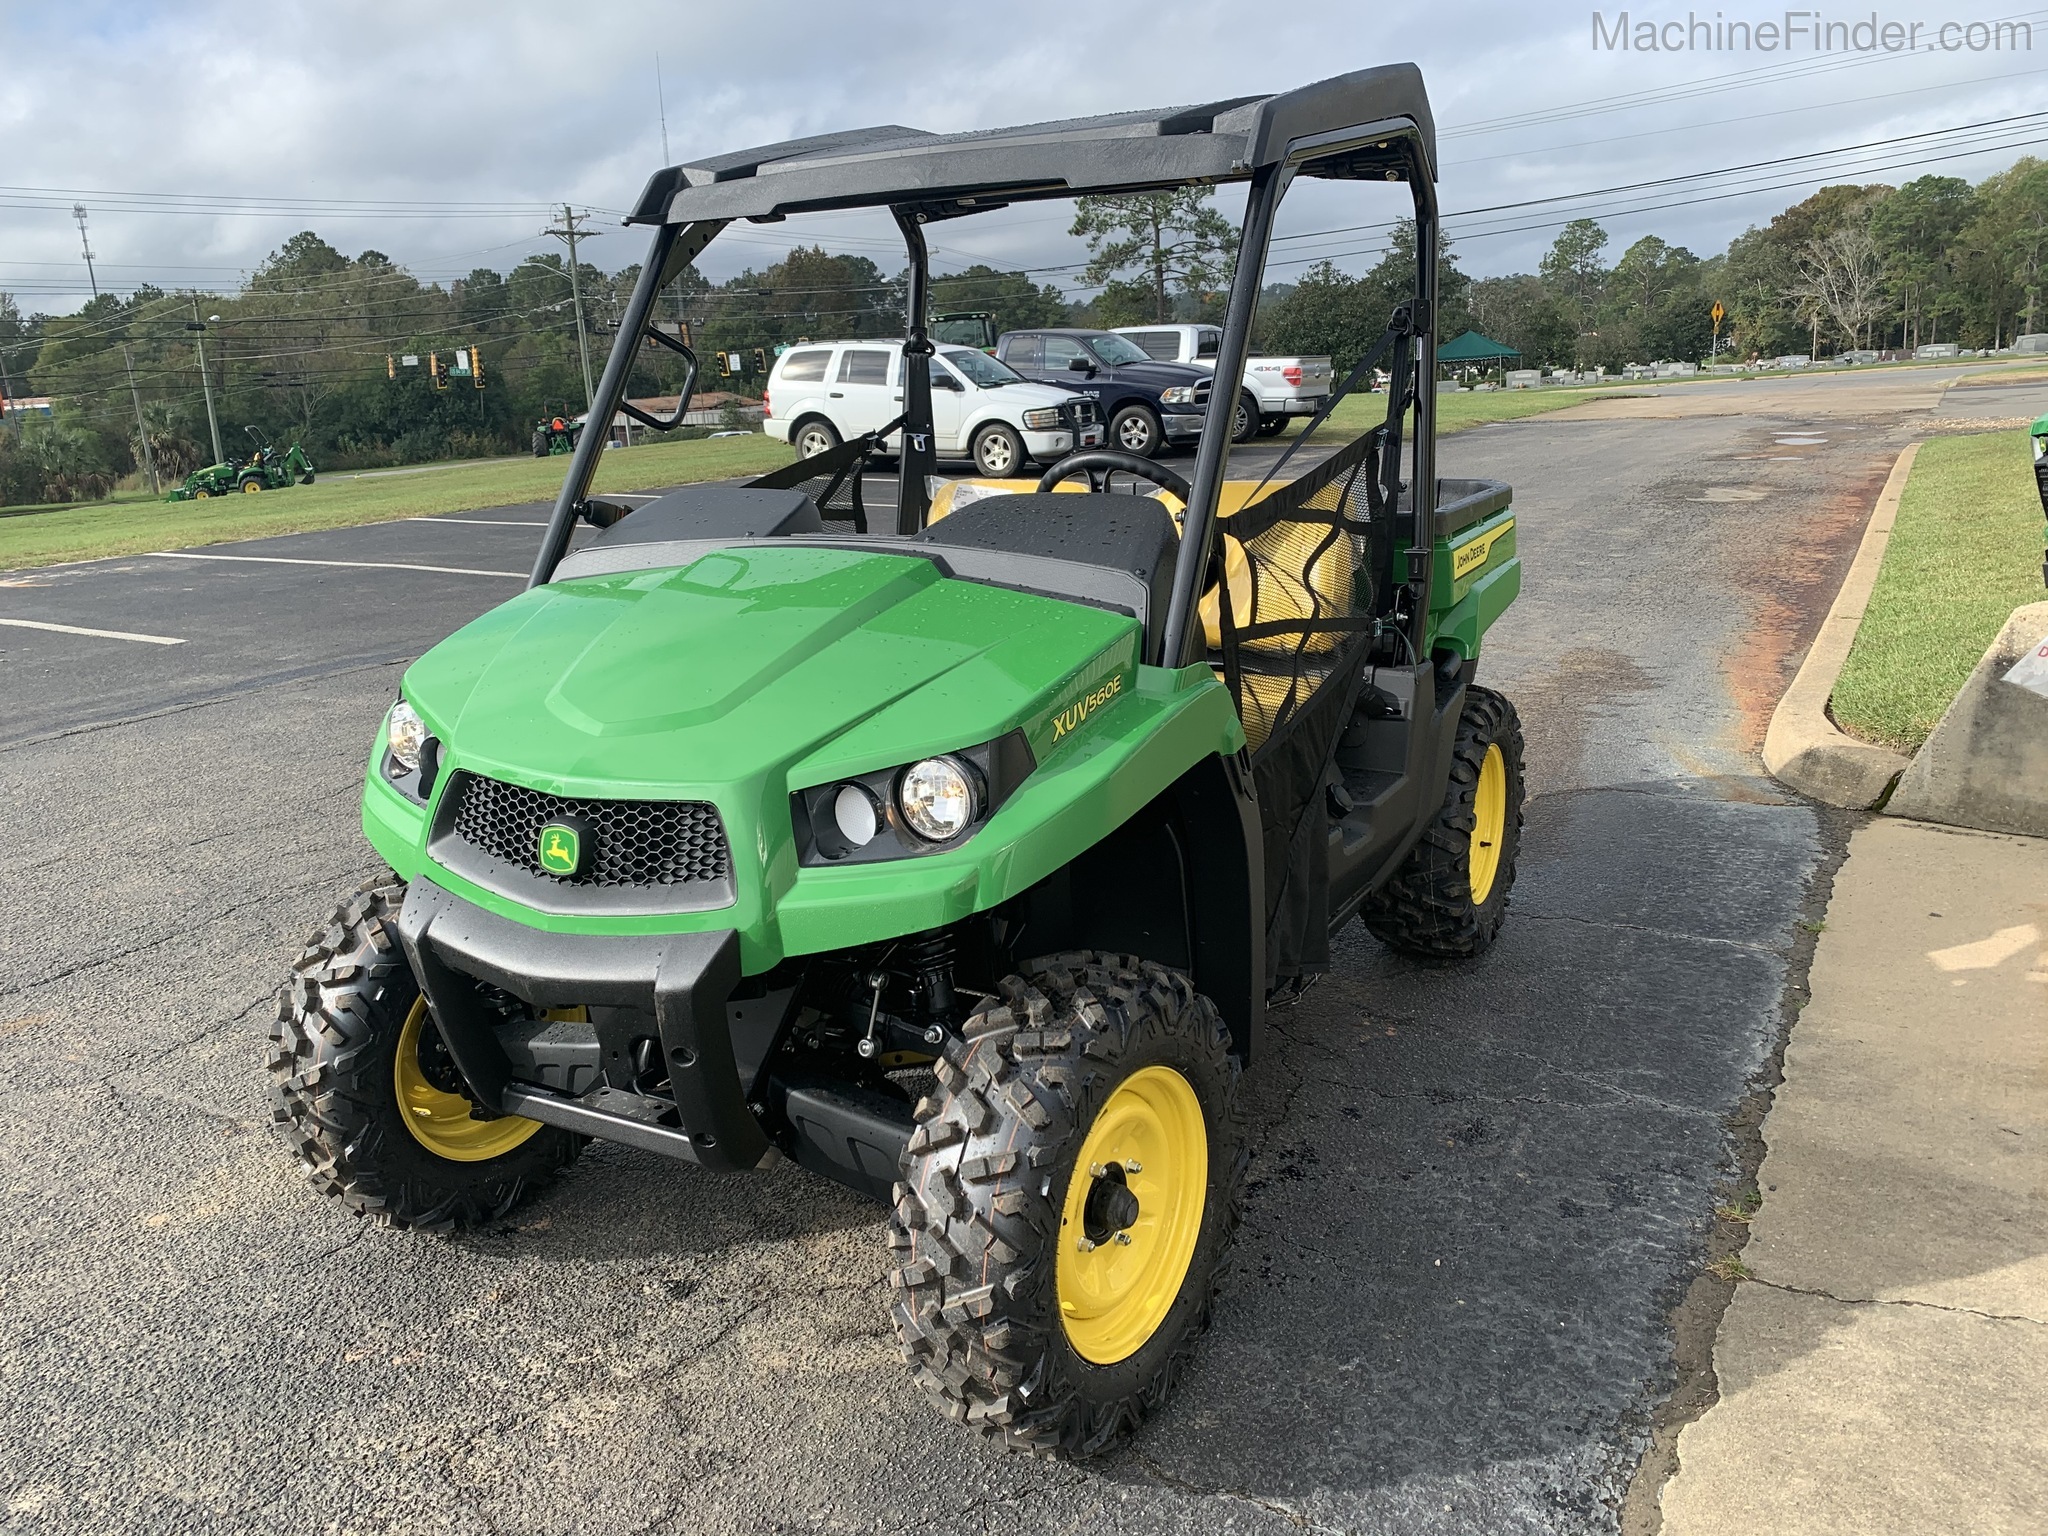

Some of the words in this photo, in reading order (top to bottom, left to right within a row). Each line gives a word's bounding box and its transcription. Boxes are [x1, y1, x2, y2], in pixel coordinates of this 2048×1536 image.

[1457, 552, 1470, 569] JOHN
[1470, 543, 1485, 561] DEERE
[1052, 673, 1122, 744] XUV560E
